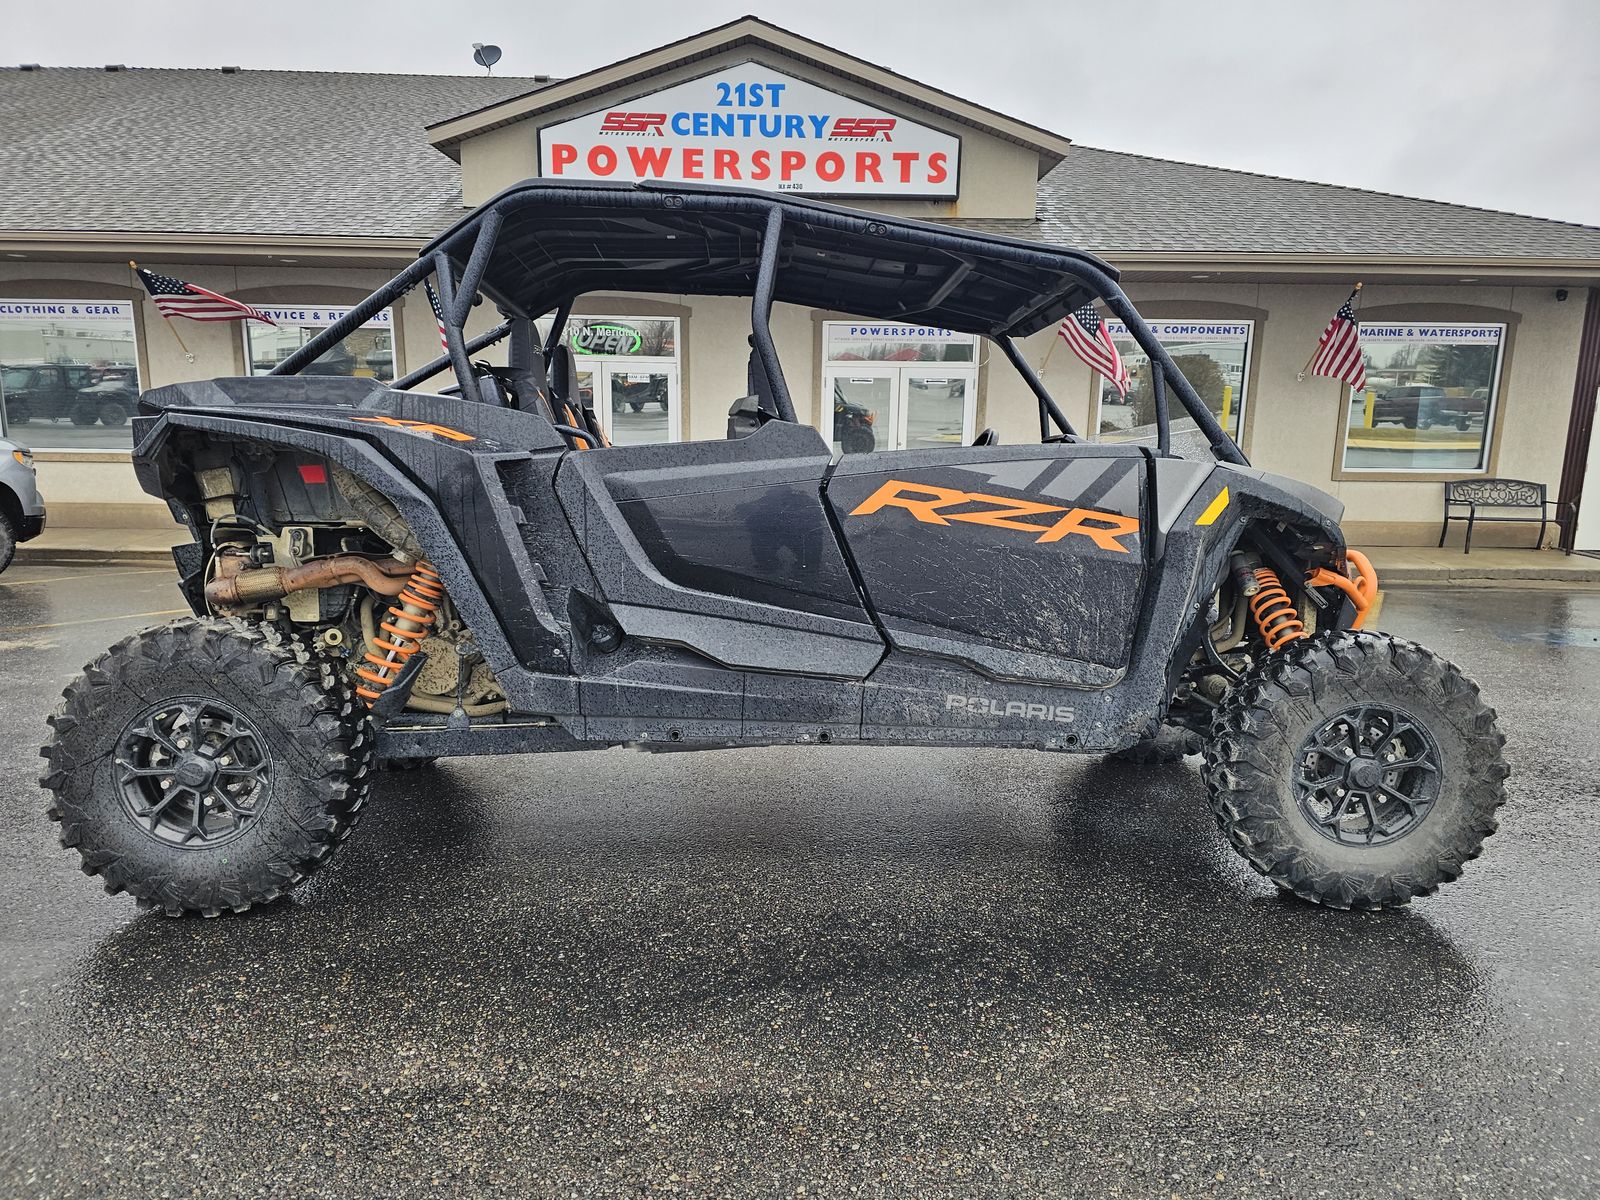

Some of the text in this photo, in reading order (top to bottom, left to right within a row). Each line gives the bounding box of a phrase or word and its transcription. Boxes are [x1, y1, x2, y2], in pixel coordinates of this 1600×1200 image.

[716, 83, 786, 108] 21ST
[601, 112, 667, 137] SSR
[671, 112, 830, 139] CENTURY
[830, 118, 897, 143] SSR
[551, 143, 948, 184] POWERSPORTS
[0, 305, 120, 315] CLOTHING & GEAR
[313, 311, 320, 320] &
[596, 326, 641, 336] Meridian
[850, 327, 952, 336] POWERSPORTS
[1151, 325, 1246, 335] & COMPONENTS
[1360, 328, 1499, 338] MARINE & WATERSPORTS
[577, 331, 633, 353] OPEN
[1461, 488, 1528, 501] WELCOME
[848, 480, 1140, 554] RZR
[945, 694, 1076, 723] POLARIS
